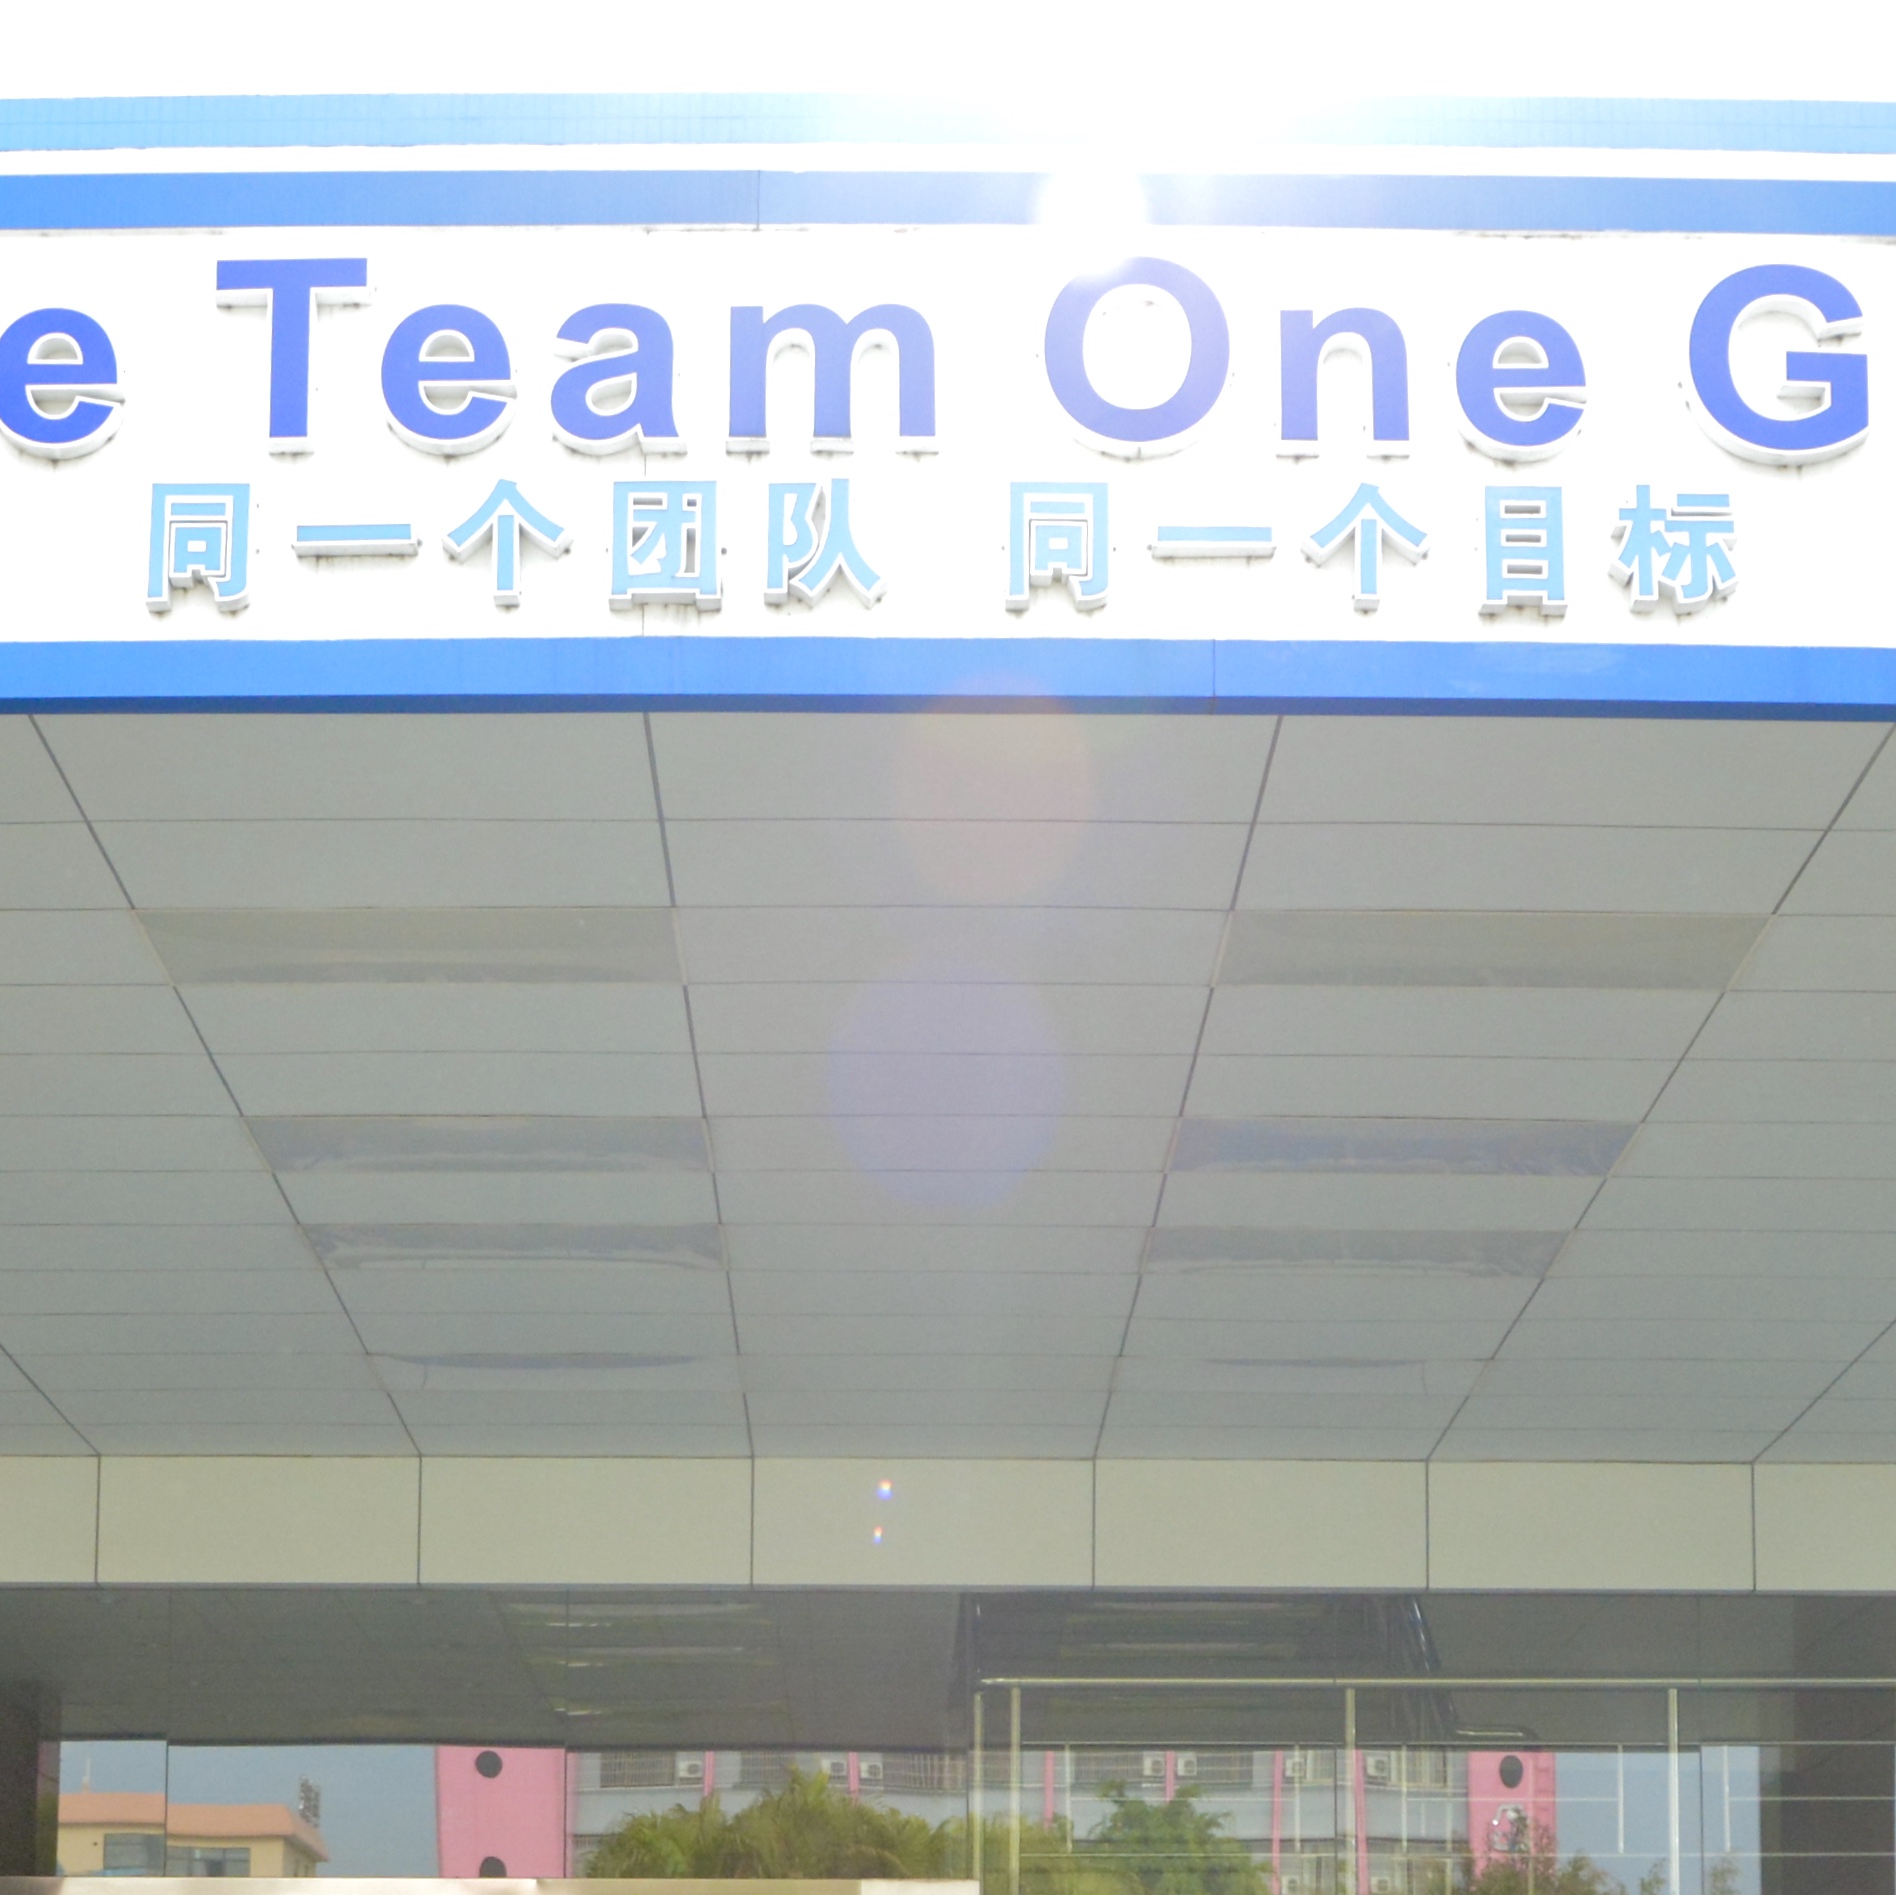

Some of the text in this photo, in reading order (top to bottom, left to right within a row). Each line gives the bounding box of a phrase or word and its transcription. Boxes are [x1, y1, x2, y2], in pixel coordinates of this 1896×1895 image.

[216, 257, 937, 455] Team
[1043, 256, 1587, 461] One
[146, 478, 1739, 616] 同一个团队 同一个目标
